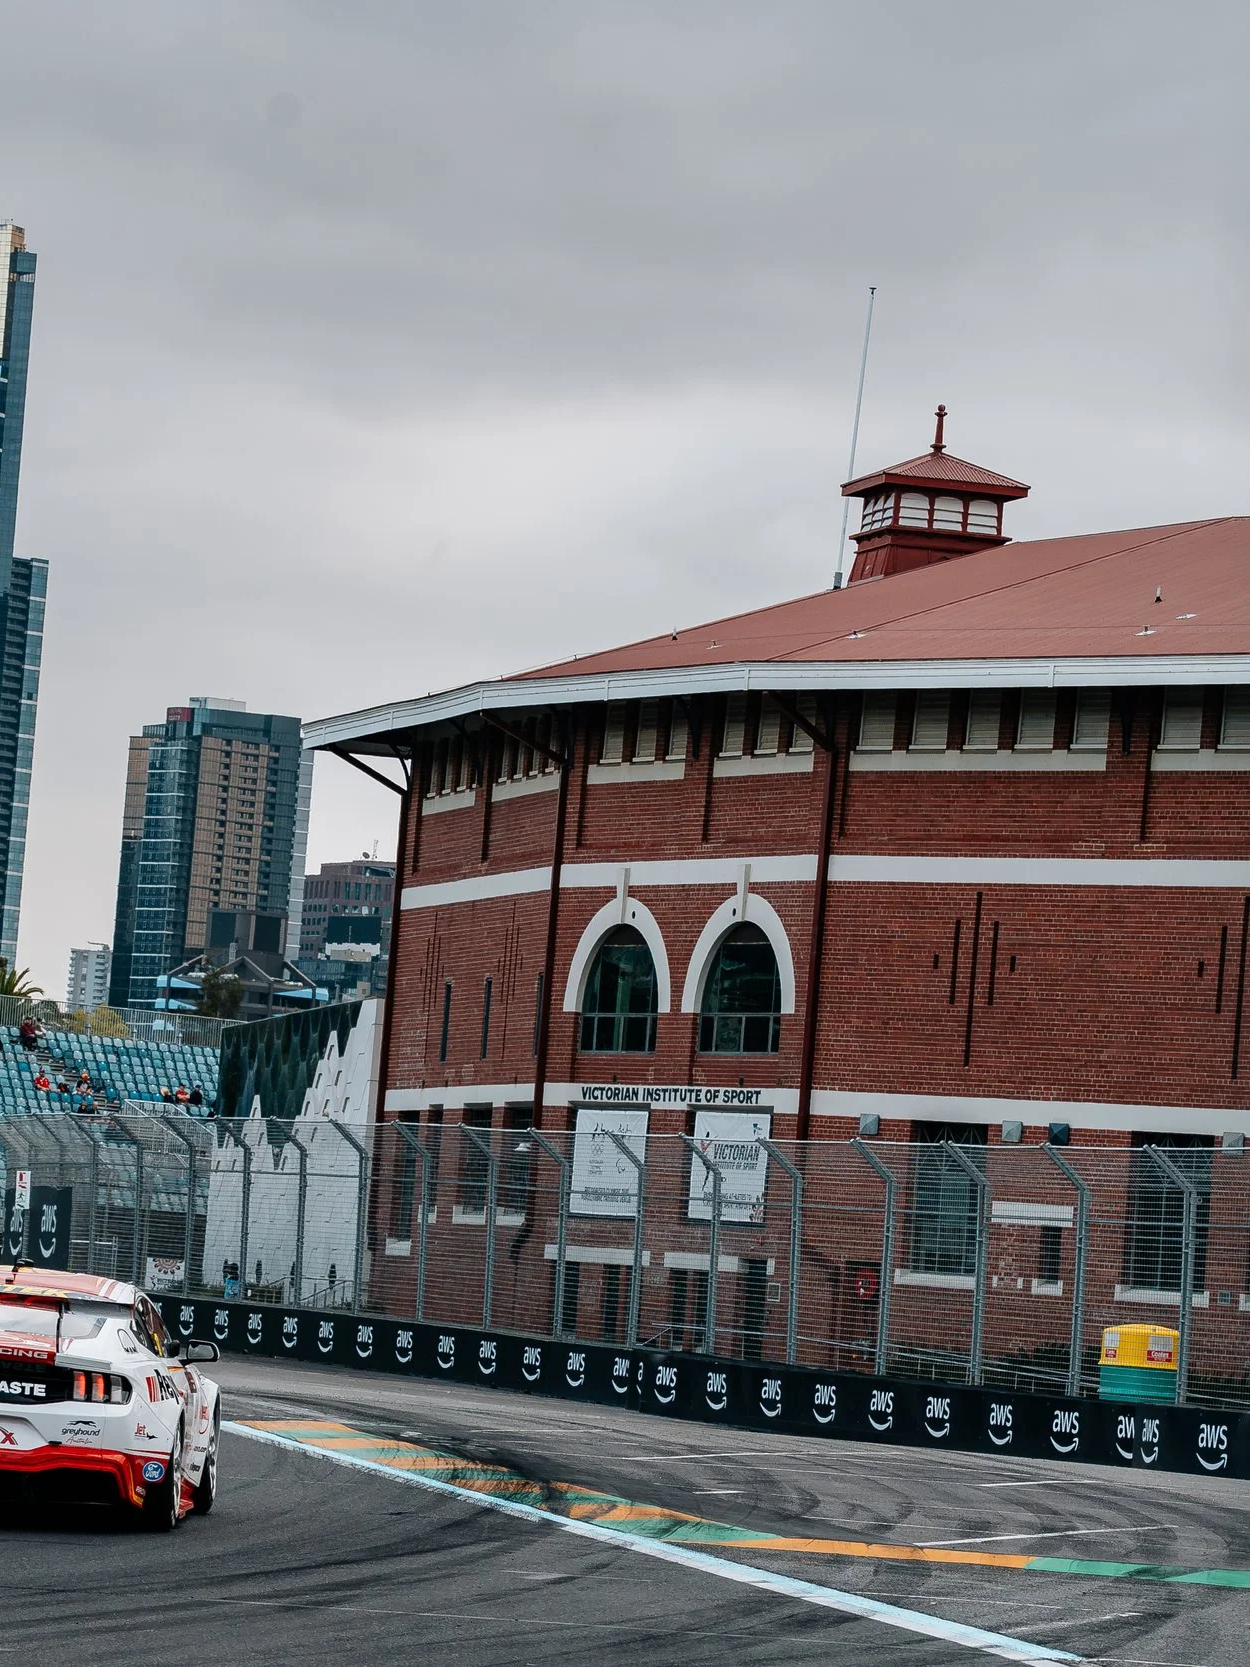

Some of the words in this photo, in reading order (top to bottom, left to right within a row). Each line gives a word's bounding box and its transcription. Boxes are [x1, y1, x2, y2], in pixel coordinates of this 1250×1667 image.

[581, 1086, 639, 1101] VICTORIAN
[642, 1087, 701, 1102] INSTITUTE
[704, 1089, 720, 1103] OF
[722, 1089, 761, 1105] SPORT
[713, 1143, 761, 1161] VICTORIAN
[180, 1305, 195, 1322] aws
[214, 1309, 229, 1327] aws
[248, 1313, 262, 1330] aws
[283, 1316, 298, 1334] aws
[319, 1321, 334, 1338] aws
[357, 1325, 373, 1344] aws
[396, 1330, 413, 1349] aws
[438, 1335, 455, 1354] aws
[479, 1340, 497, 1360] aws
[523, 1346, 541, 1366] aws
[567, 1351, 585, 1371] aws
[655, 1365, 678, 1387] aws
[706, 1372, 727, 1394] aws
[761, 1378, 782, 1400] aws
[815, 1384, 836, 1406] aws
[870, 1389, 894, 1413] aws
[926, 1396, 950, 1419] aws
[990, 1403, 1013, 1427] aws
[1052, 1410, 1079, 1435] aws
[61, 1428, 101, 1436] greyhound
[134, 1422, 146, 1436] Jet
[1142, 1418, 1160, 1443] aws
[1198, 1423, 1228, 1450] aws
[145, 1463, 161, 1478] Ford
